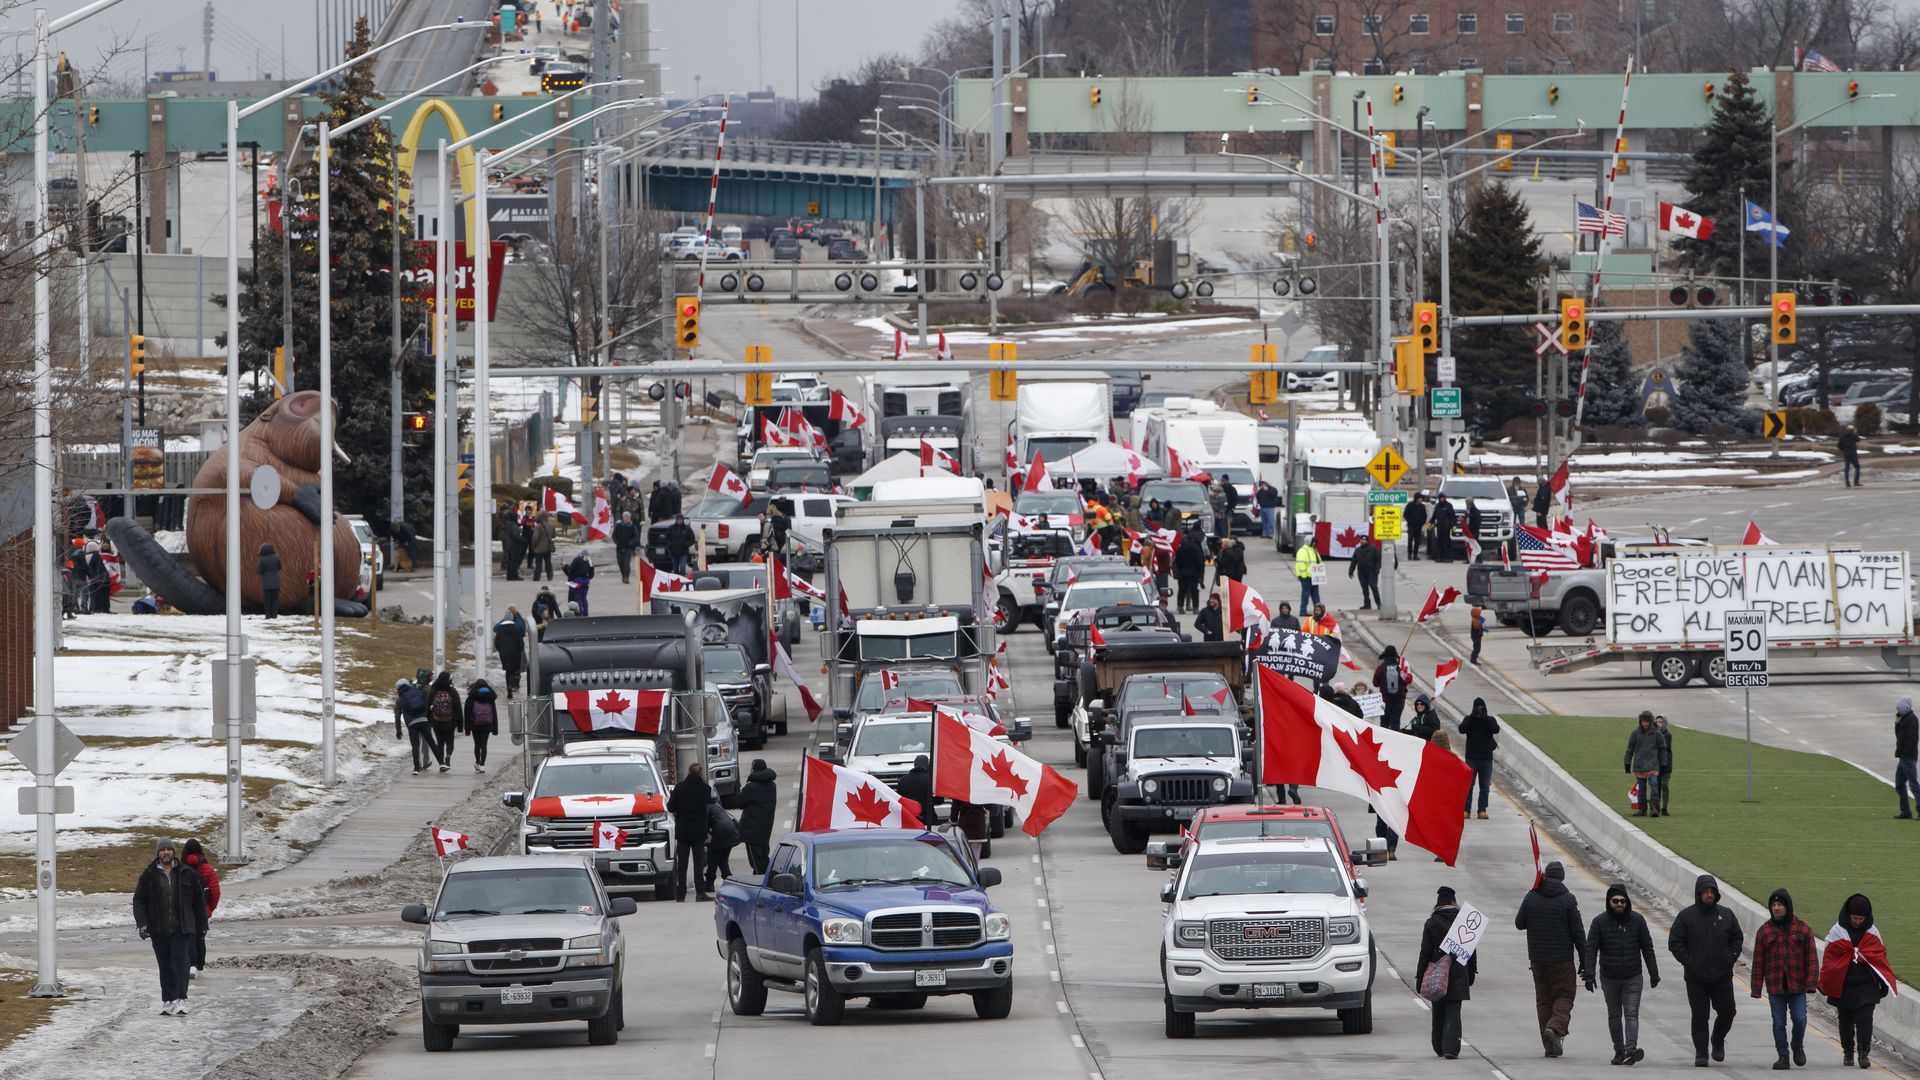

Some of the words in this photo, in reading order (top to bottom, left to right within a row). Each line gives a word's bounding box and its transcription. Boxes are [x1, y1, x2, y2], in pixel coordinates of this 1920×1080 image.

[511, 208, 549, 216] MATASS
[132, 430, 141, 438] IG
[141, 430, 158, 438] MAC
[133, 438, 159, 447] ACON!
[1369, 492, 1399, 503] College
[1613, 563, 1676, 580] Peace
[1685, 560, 1740, 578] LOVE
[1615, 576, 1745, 605] FREEDOM
[1755, 560, 1903, 593] MANDATE
[1613, 612, 1662, 632] FOR
[1685, 611, 1723, 631] AL
[1728, 616, 1763, 625] MAXIMUM
[1281, 627, 1299, 635] YOU
[1313, 635, 1332, 651] TAKE
[1730, 629, 1761, 652] 50
[1256, 655, 1293, 663] TRUDEAU
[1293, 658, 1305, 666] TO
[1308, 661, 1324, 671] THE
[1732, 661, 1761, 671] km/h
[1262, 662, 1285, 670] RAIN
[1284, 664, 1323, 679] STATION
[1728, 675, 1766, 686] BEGINS
[1244, 926, 1290, 939] GMC
